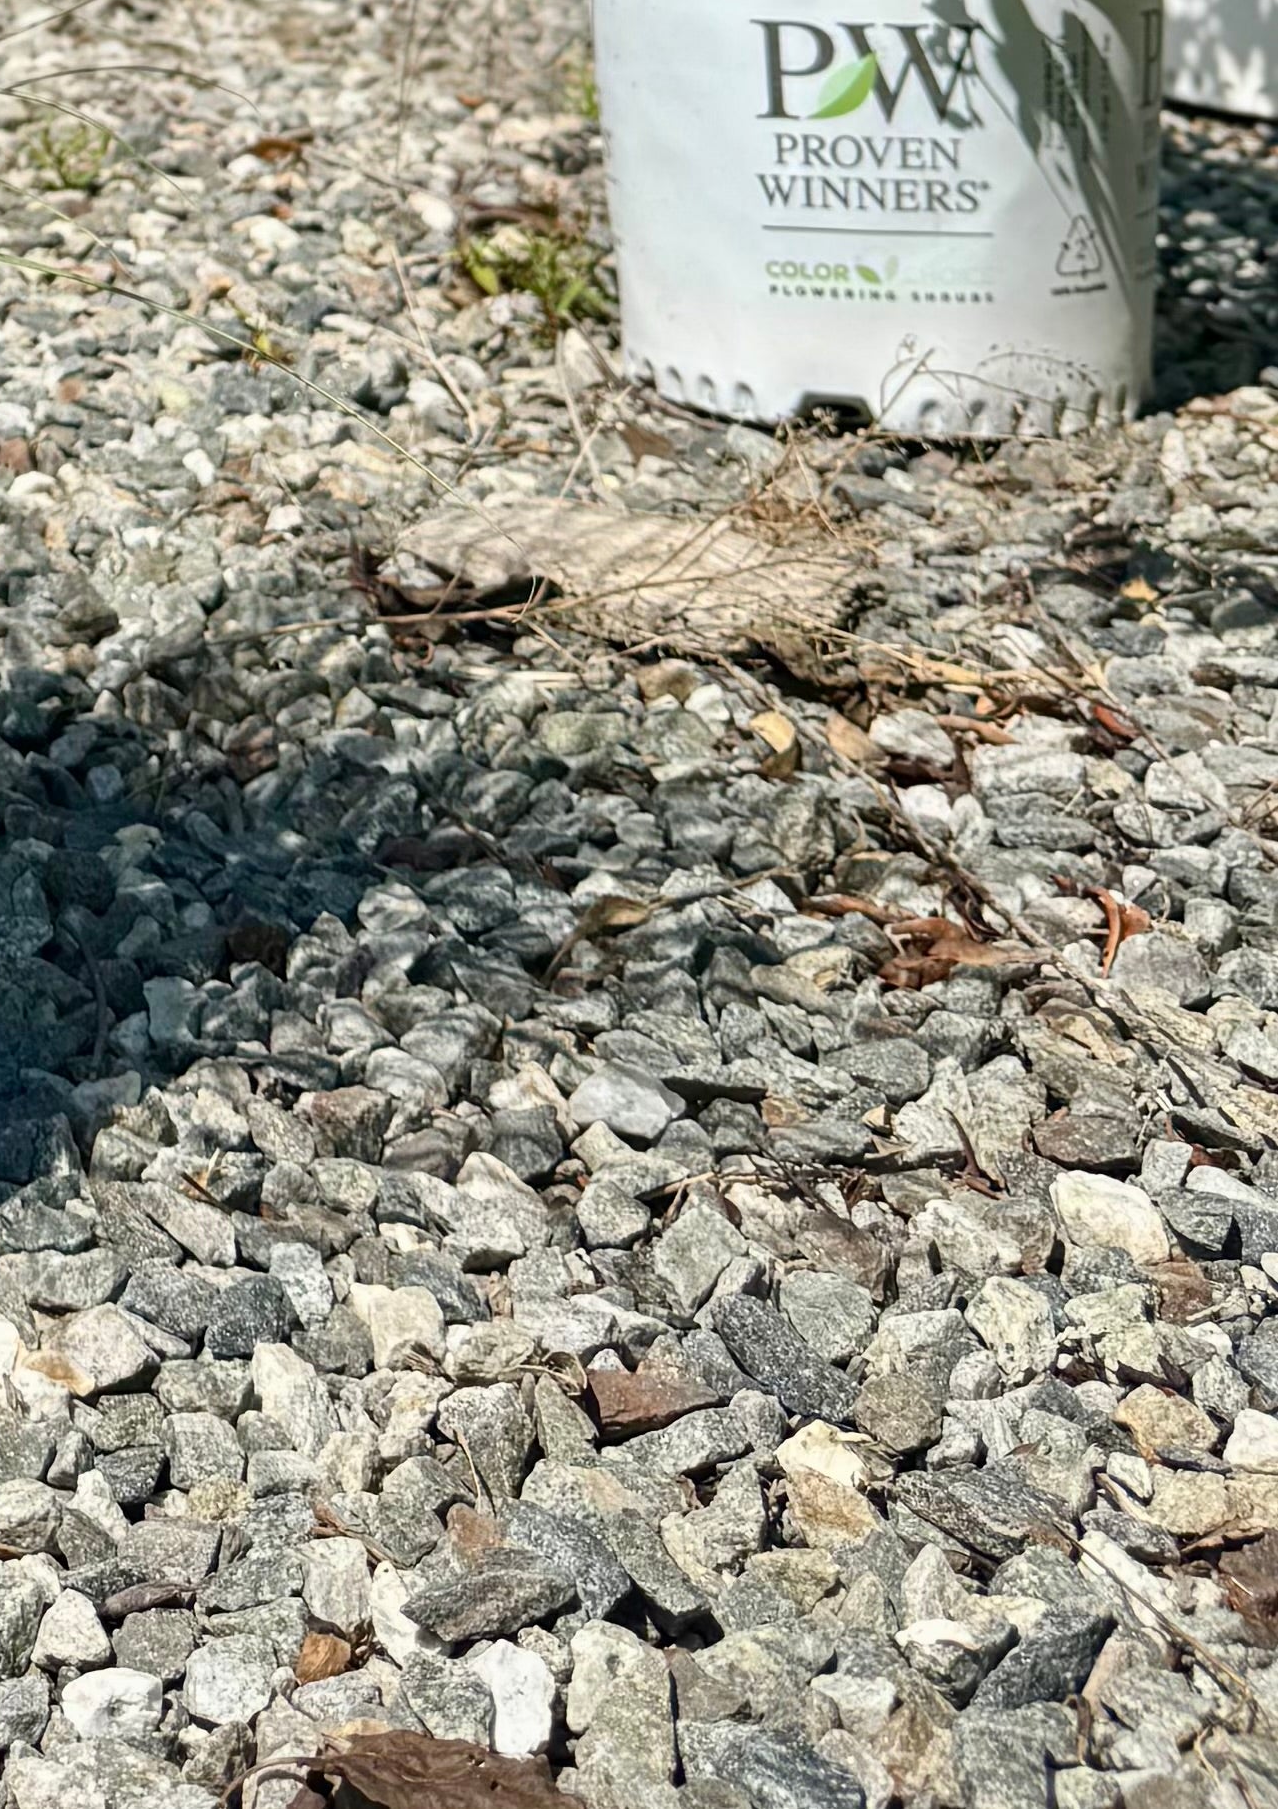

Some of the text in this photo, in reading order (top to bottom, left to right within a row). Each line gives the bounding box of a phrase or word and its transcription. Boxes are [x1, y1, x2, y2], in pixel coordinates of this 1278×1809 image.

[749, 18, 984, 125] PW
[773, 131, 963, 172] PROVEN
[764, 259, 850, 282] COLOR
